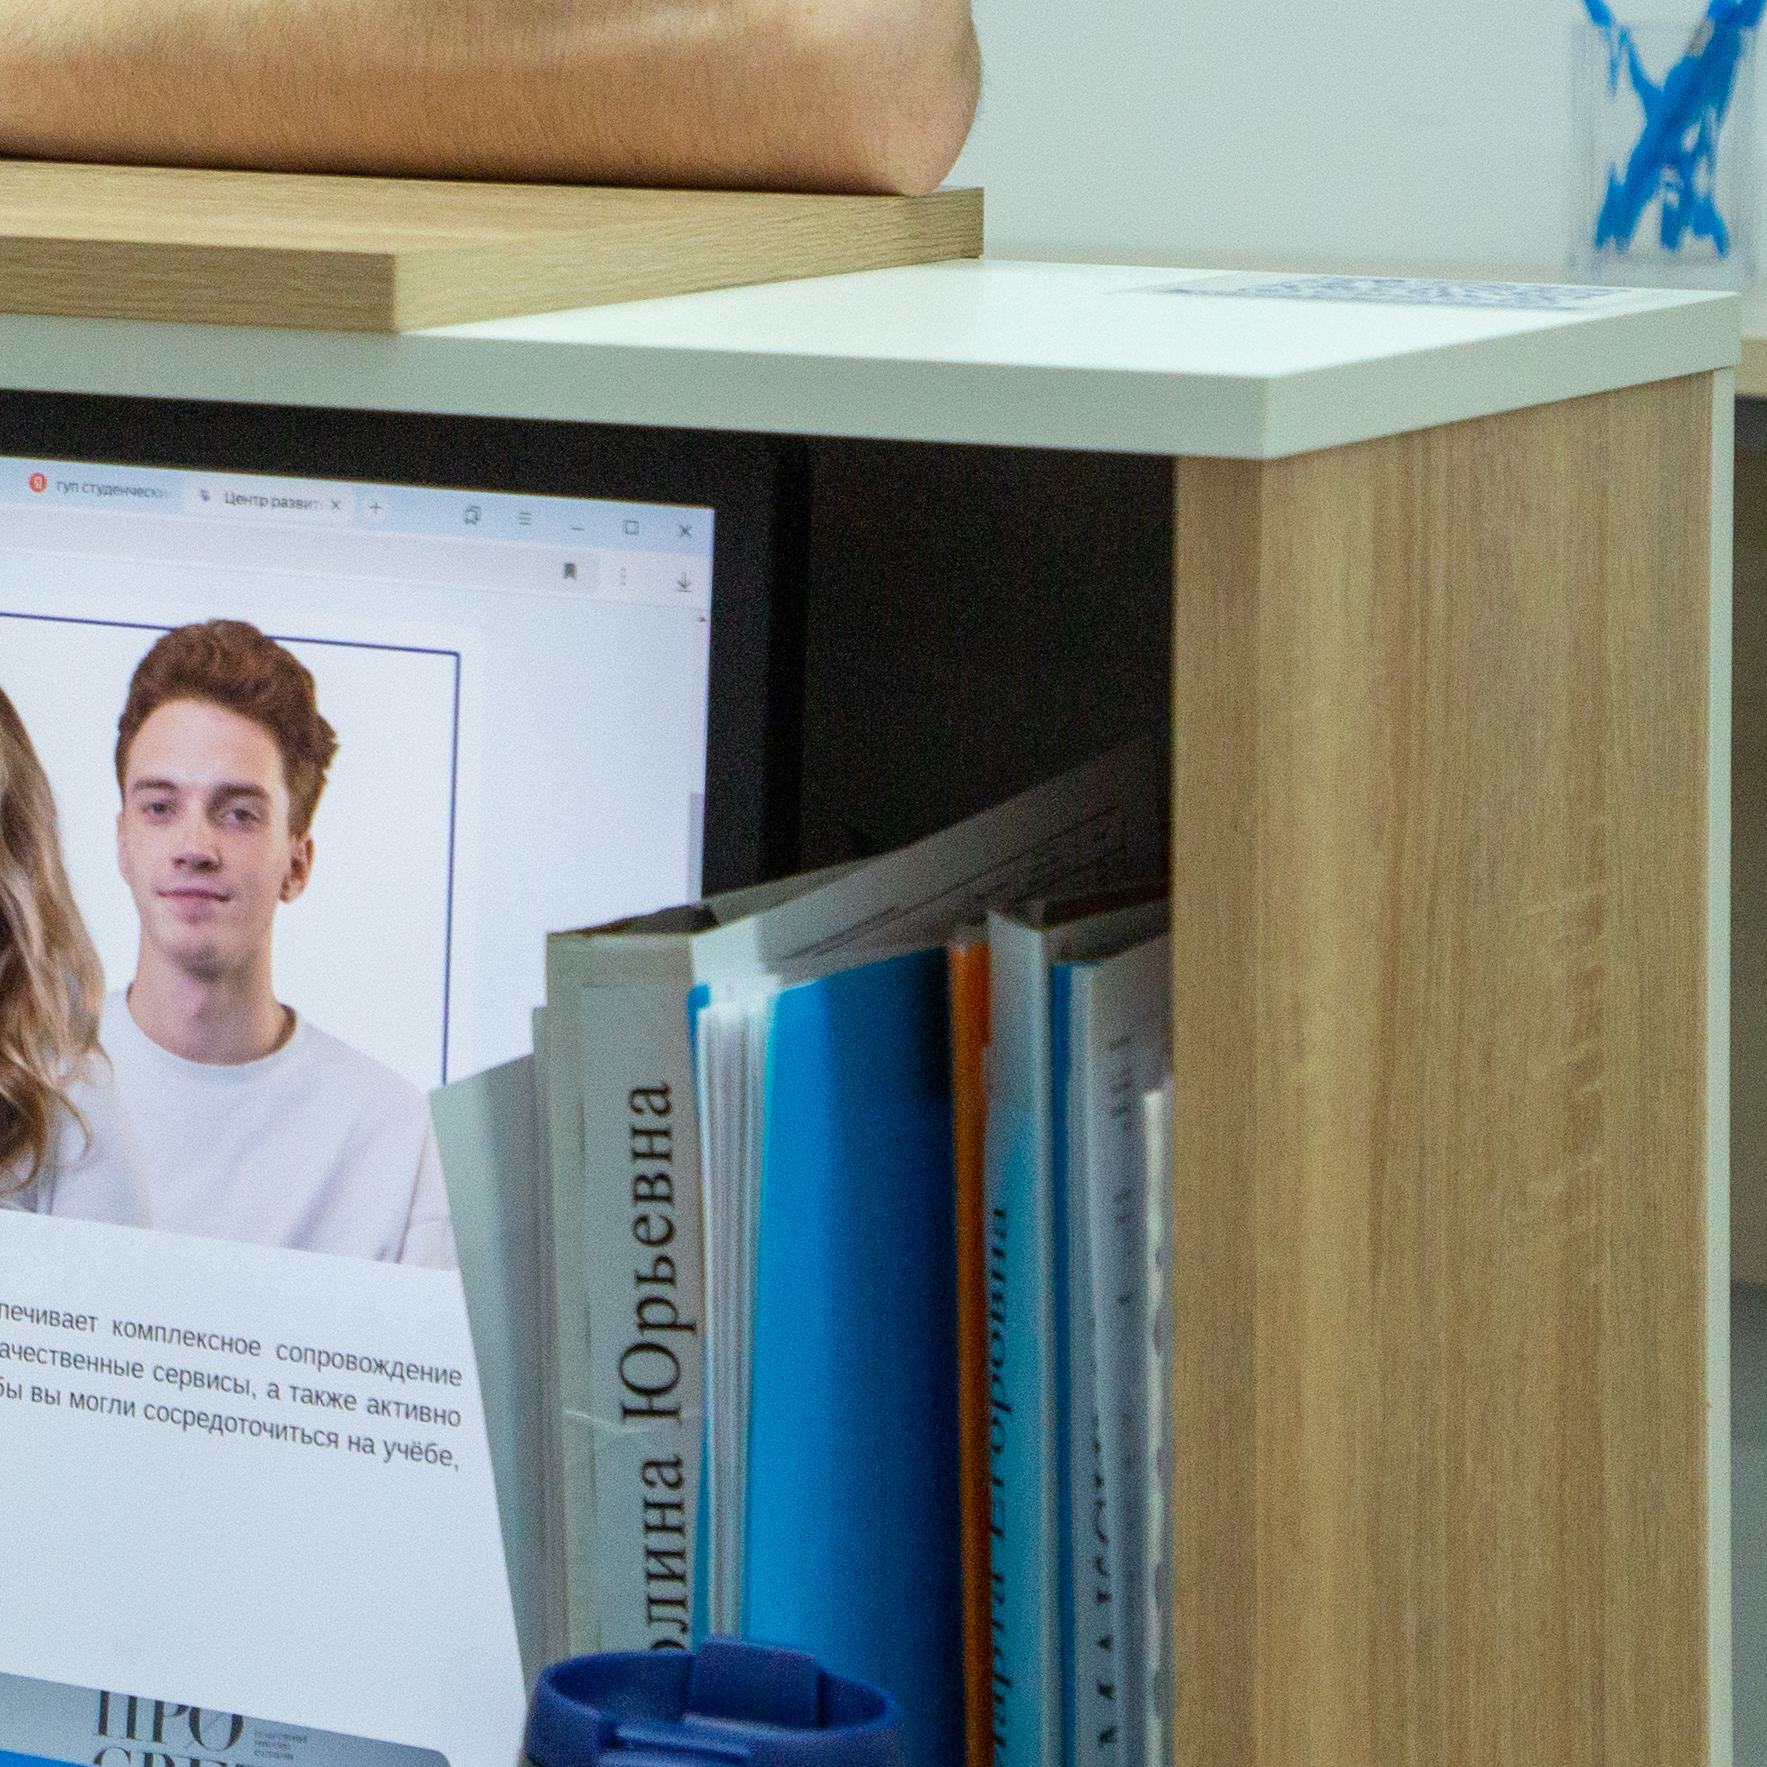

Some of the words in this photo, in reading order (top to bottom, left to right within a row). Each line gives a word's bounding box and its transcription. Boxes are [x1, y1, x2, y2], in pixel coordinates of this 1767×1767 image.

[223, 491, 272, 509] Центр
[619, 1082, 698, 1424] Юрьевна
[112, 1320, 261, 1357] комплексное
[275, 1343, 462, 1387] сопровождение
[30, 1385, 61, 1406] вы
[69, 1392, 136, 1417] могли
[143, 1403, 339, 1449] сосредоточиться
[347, 1435, 376, 1455] на
[383, 1440, 459, 1471] учёбе,
[152, 1365, 256, 1399] сервисы,
[266, 1382, 281, 1400] а
[289, 1385, 357, 1411] также
[366, 1397, 461, 1427] активно
[640, 1453, 688, 1650] лина
